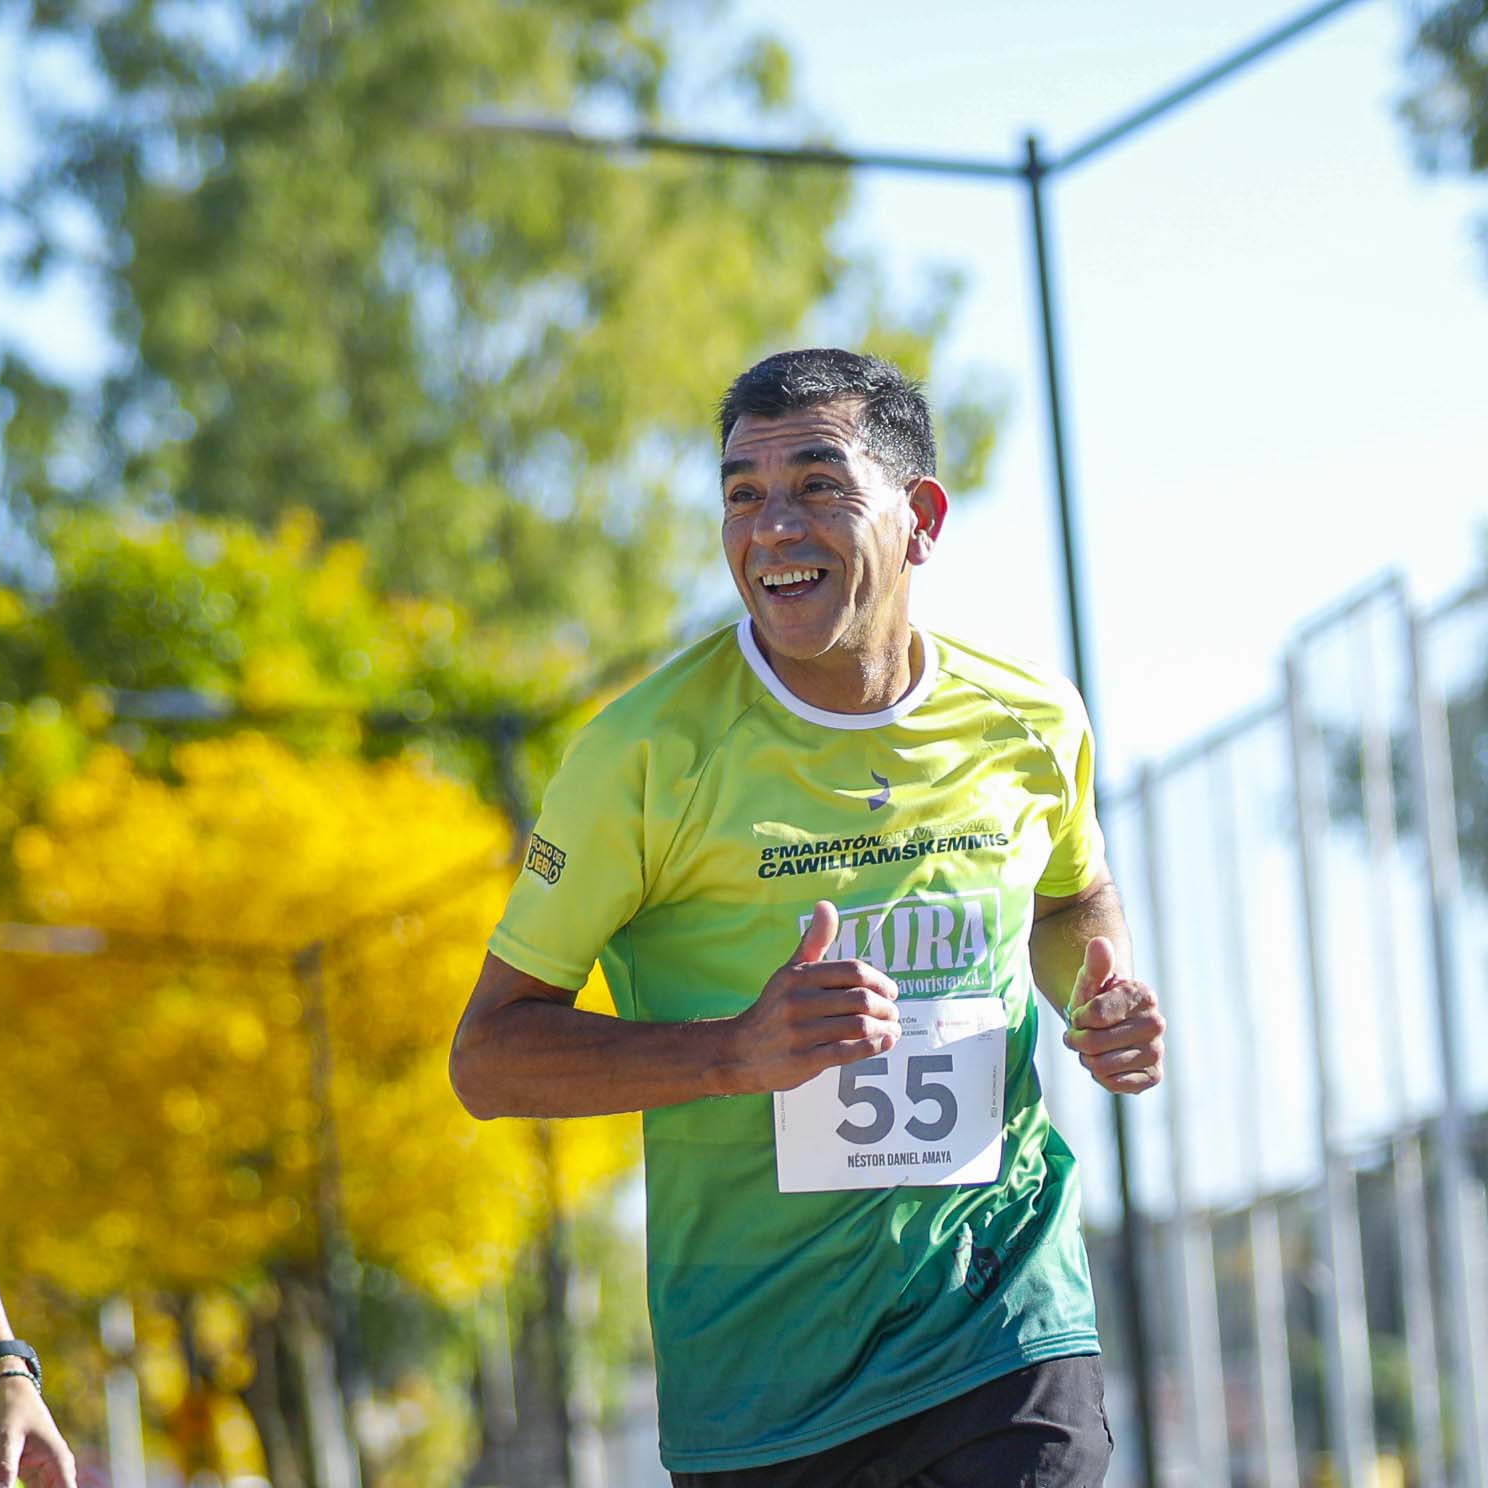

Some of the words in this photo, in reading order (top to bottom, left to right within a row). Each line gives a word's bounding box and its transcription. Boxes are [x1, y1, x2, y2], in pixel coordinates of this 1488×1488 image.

[758, 832, 1009, 878] CAWILLIAMSKEMMIS
[835, 1054, 958, 1145] 55
[847, 1152, 886, 1168] NÉSTOR
[887, 1152, 921, 1166] DANIEL
[921, 1150, 952, 1164] AMAYA
